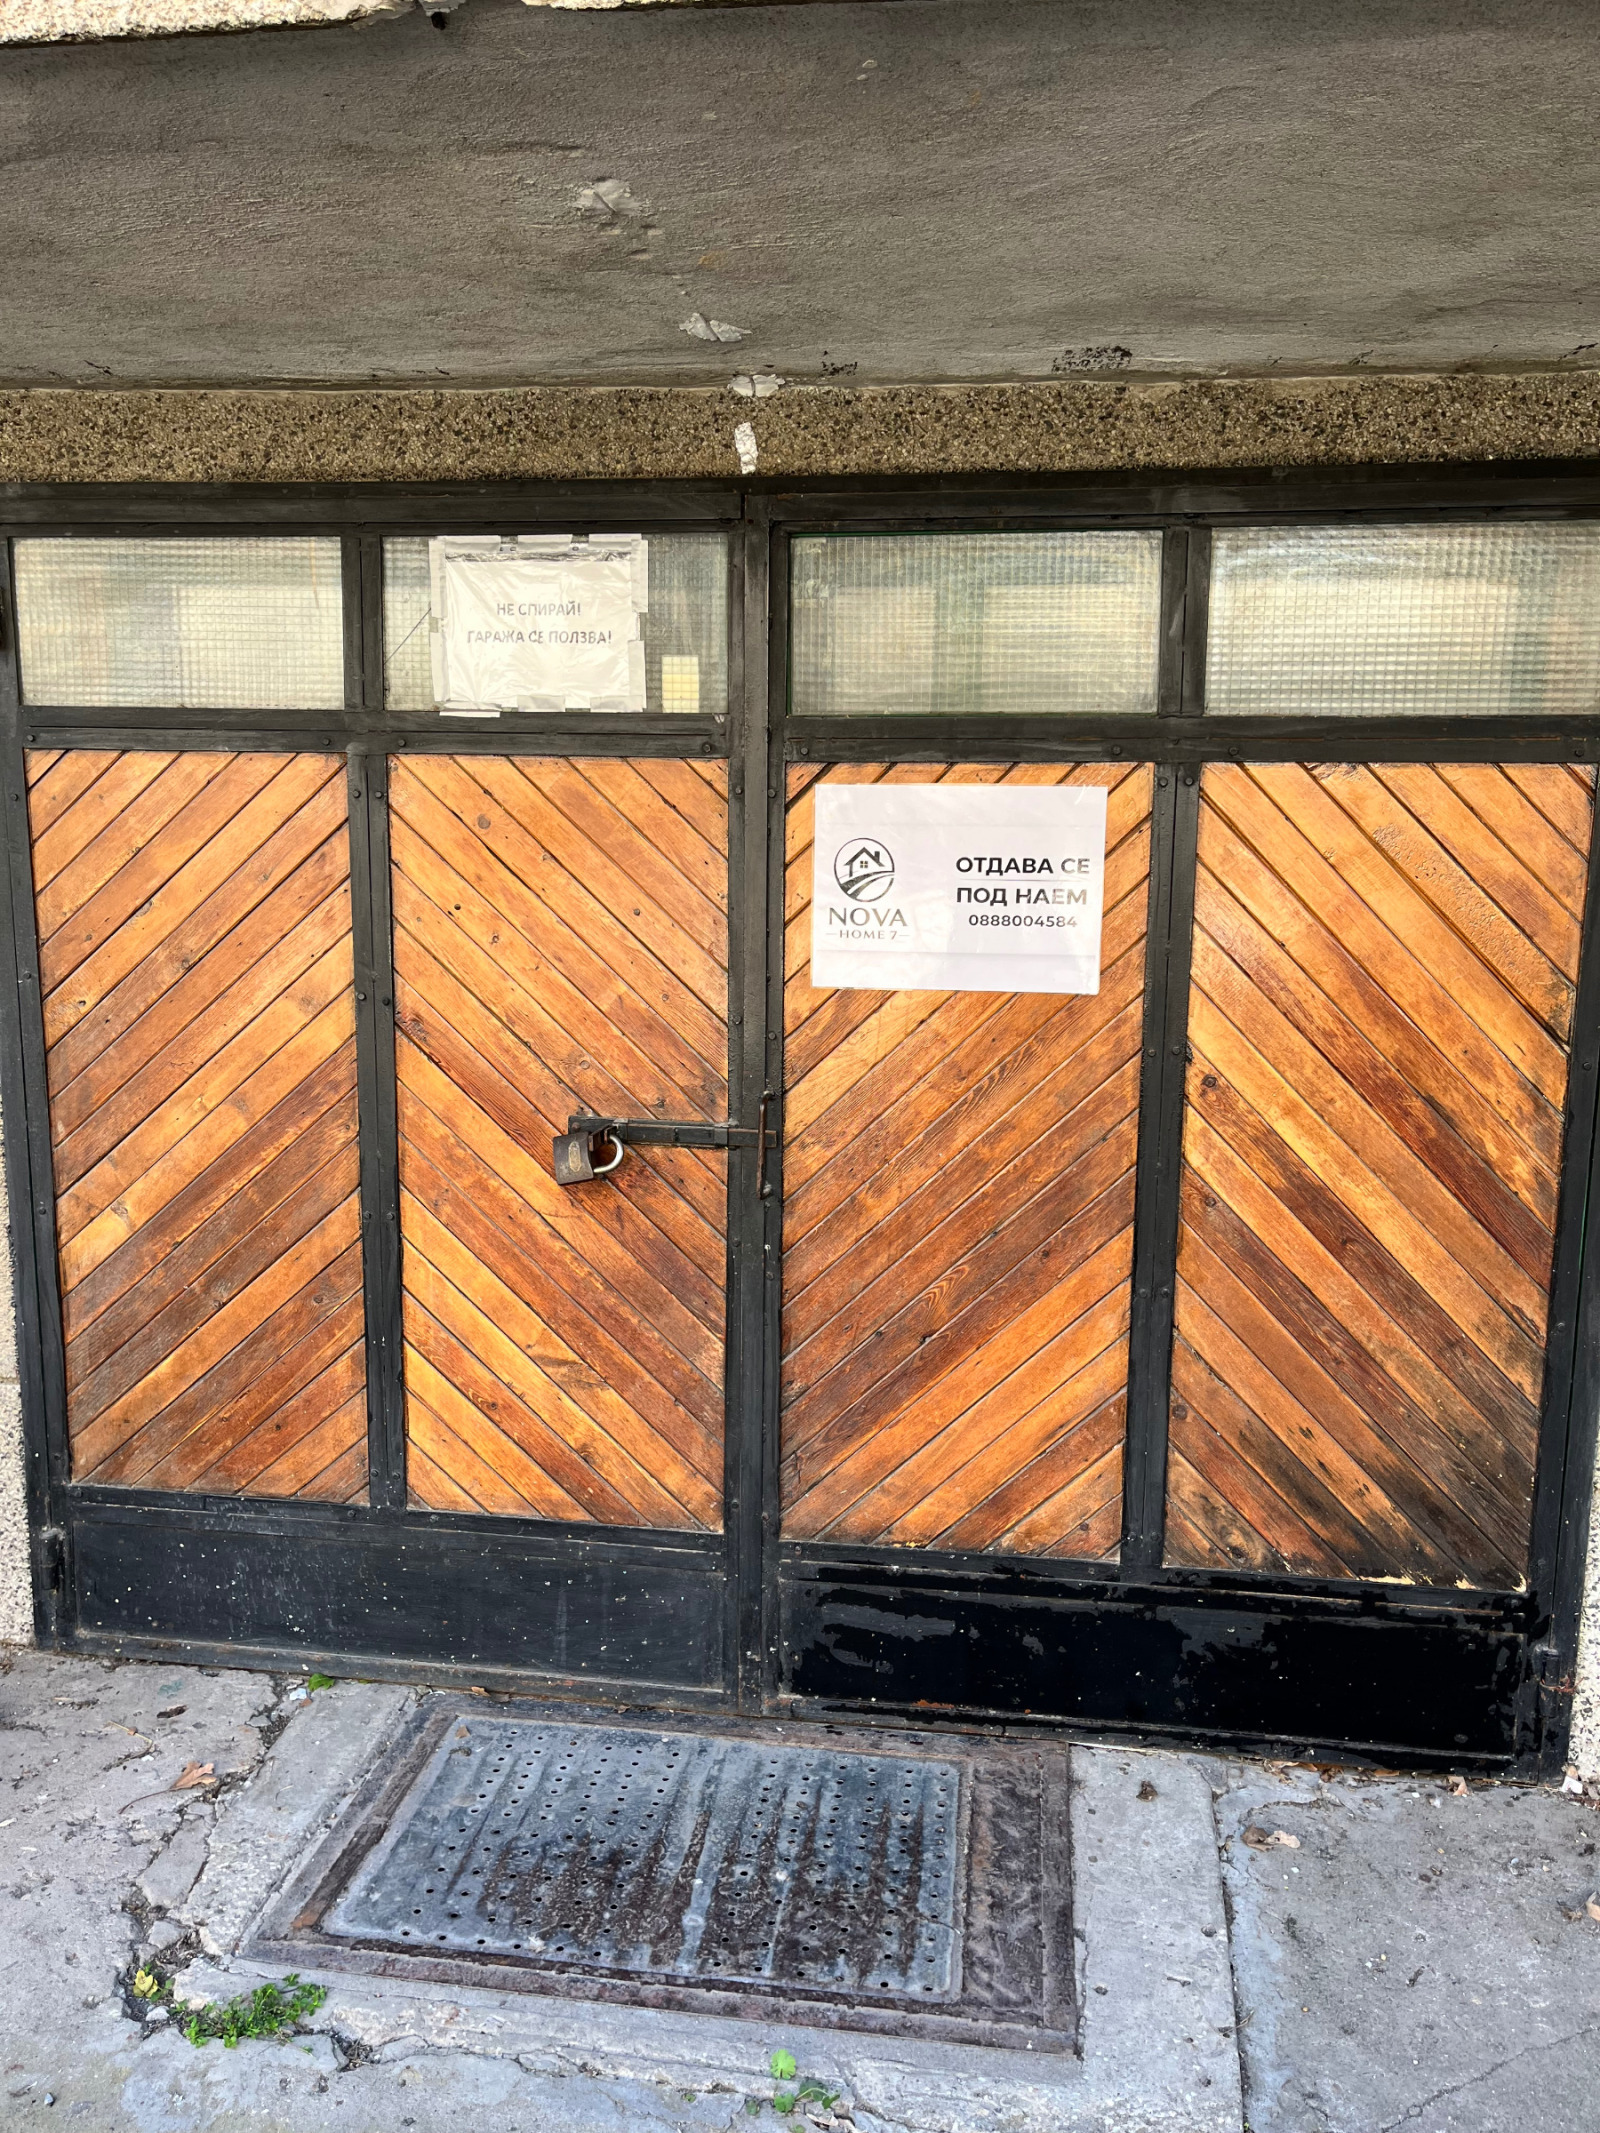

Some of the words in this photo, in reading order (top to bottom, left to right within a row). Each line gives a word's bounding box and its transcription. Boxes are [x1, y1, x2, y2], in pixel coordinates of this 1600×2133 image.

[497, 604, 514, 616] НЕ
[519, 601, 581, 616] СПИРАЙ!
[467, 630, 524, 643] ГАРАЖА
[528, 630, 544, 643] СЕ
[549, 630, 611, 644] ПОЛЗВА!
[956, 857, 1053, 876] ОТДАВА
[1061, 858, 1090, 874] СЕ
[957, 887, 1007, 906] ПОД
[1016, 889, 1087, 905] НАЕМ
[829, 907, 908, 926] NOVA
[968, 915, 1077, 927] 0888004584
[840, 929, 885, 939] HOME
[890, 930, 897, 940] 7
